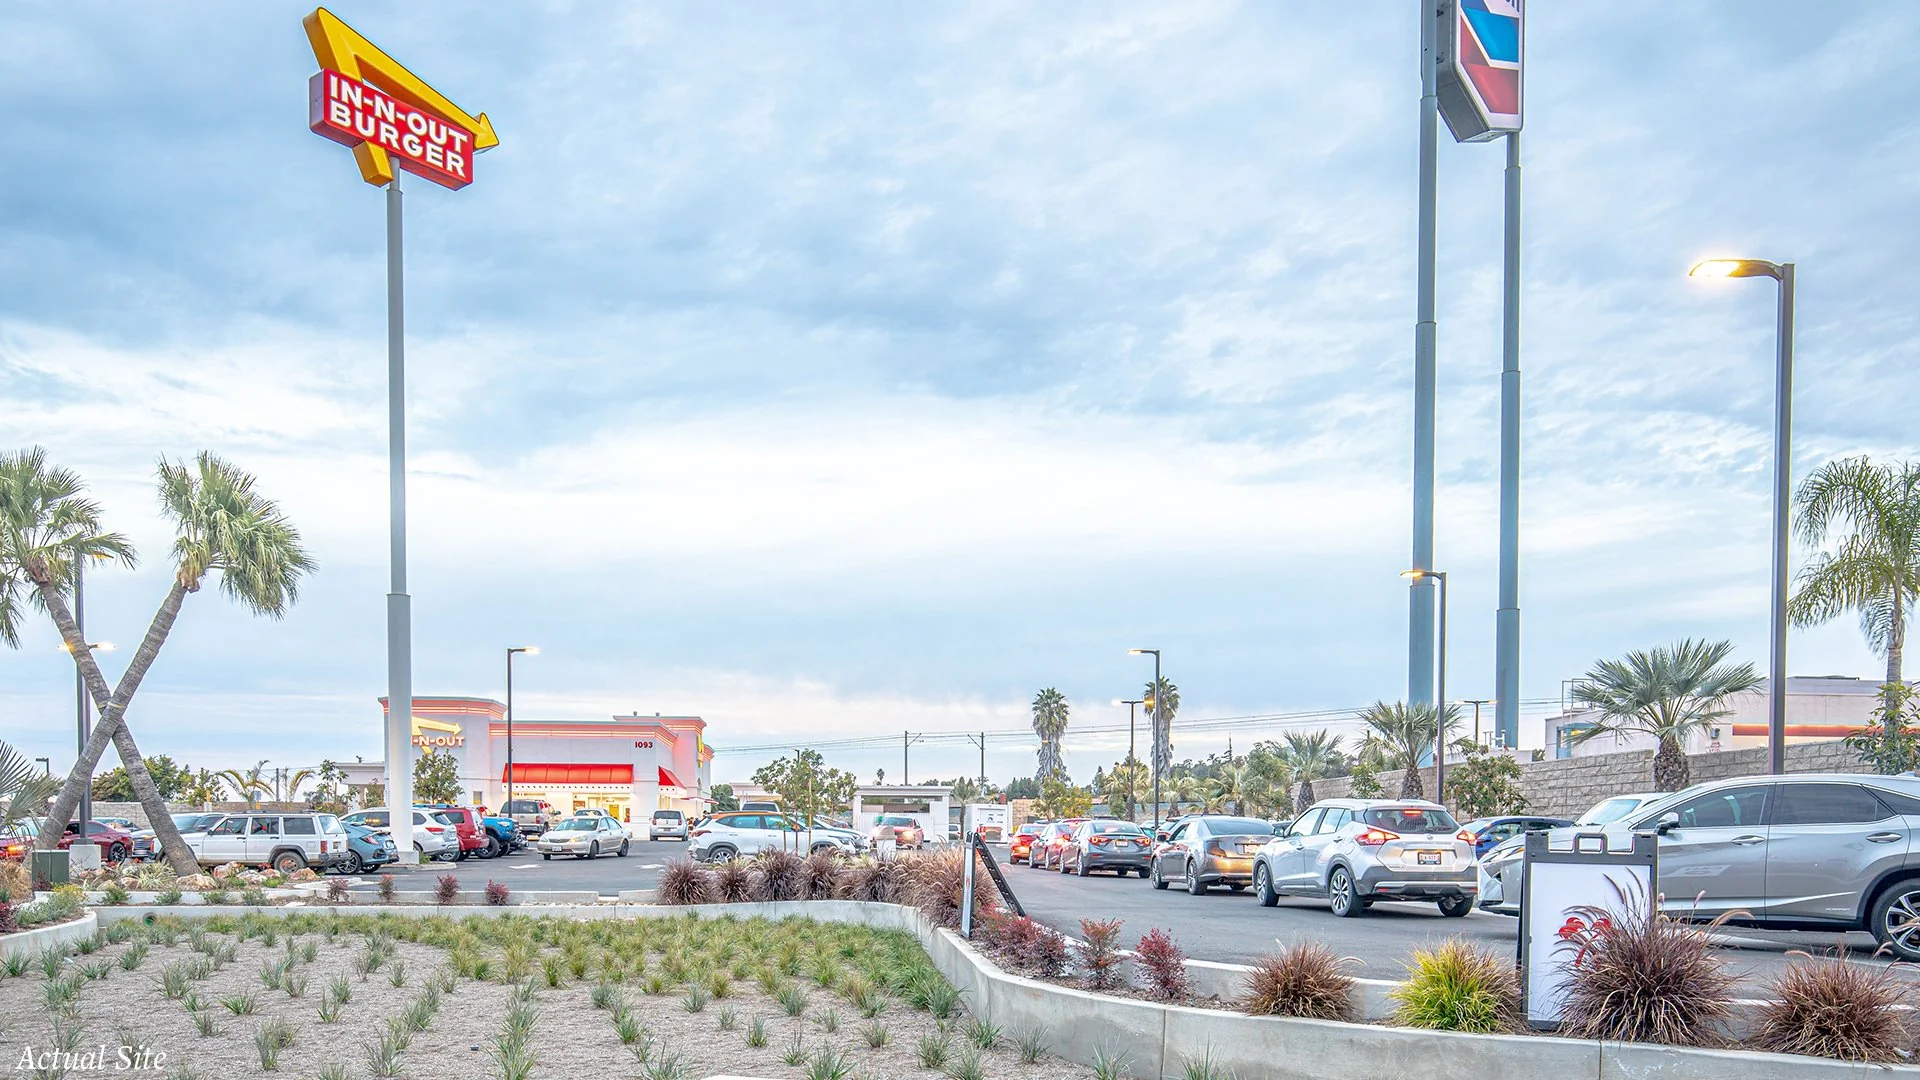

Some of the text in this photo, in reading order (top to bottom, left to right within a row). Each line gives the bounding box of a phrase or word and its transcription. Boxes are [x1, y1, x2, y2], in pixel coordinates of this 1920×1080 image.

[330, 74, 468, 153] IN-N-OUT
[330, 99, 466, 177] BURGER
[635, 741, 653, 749] 1093
